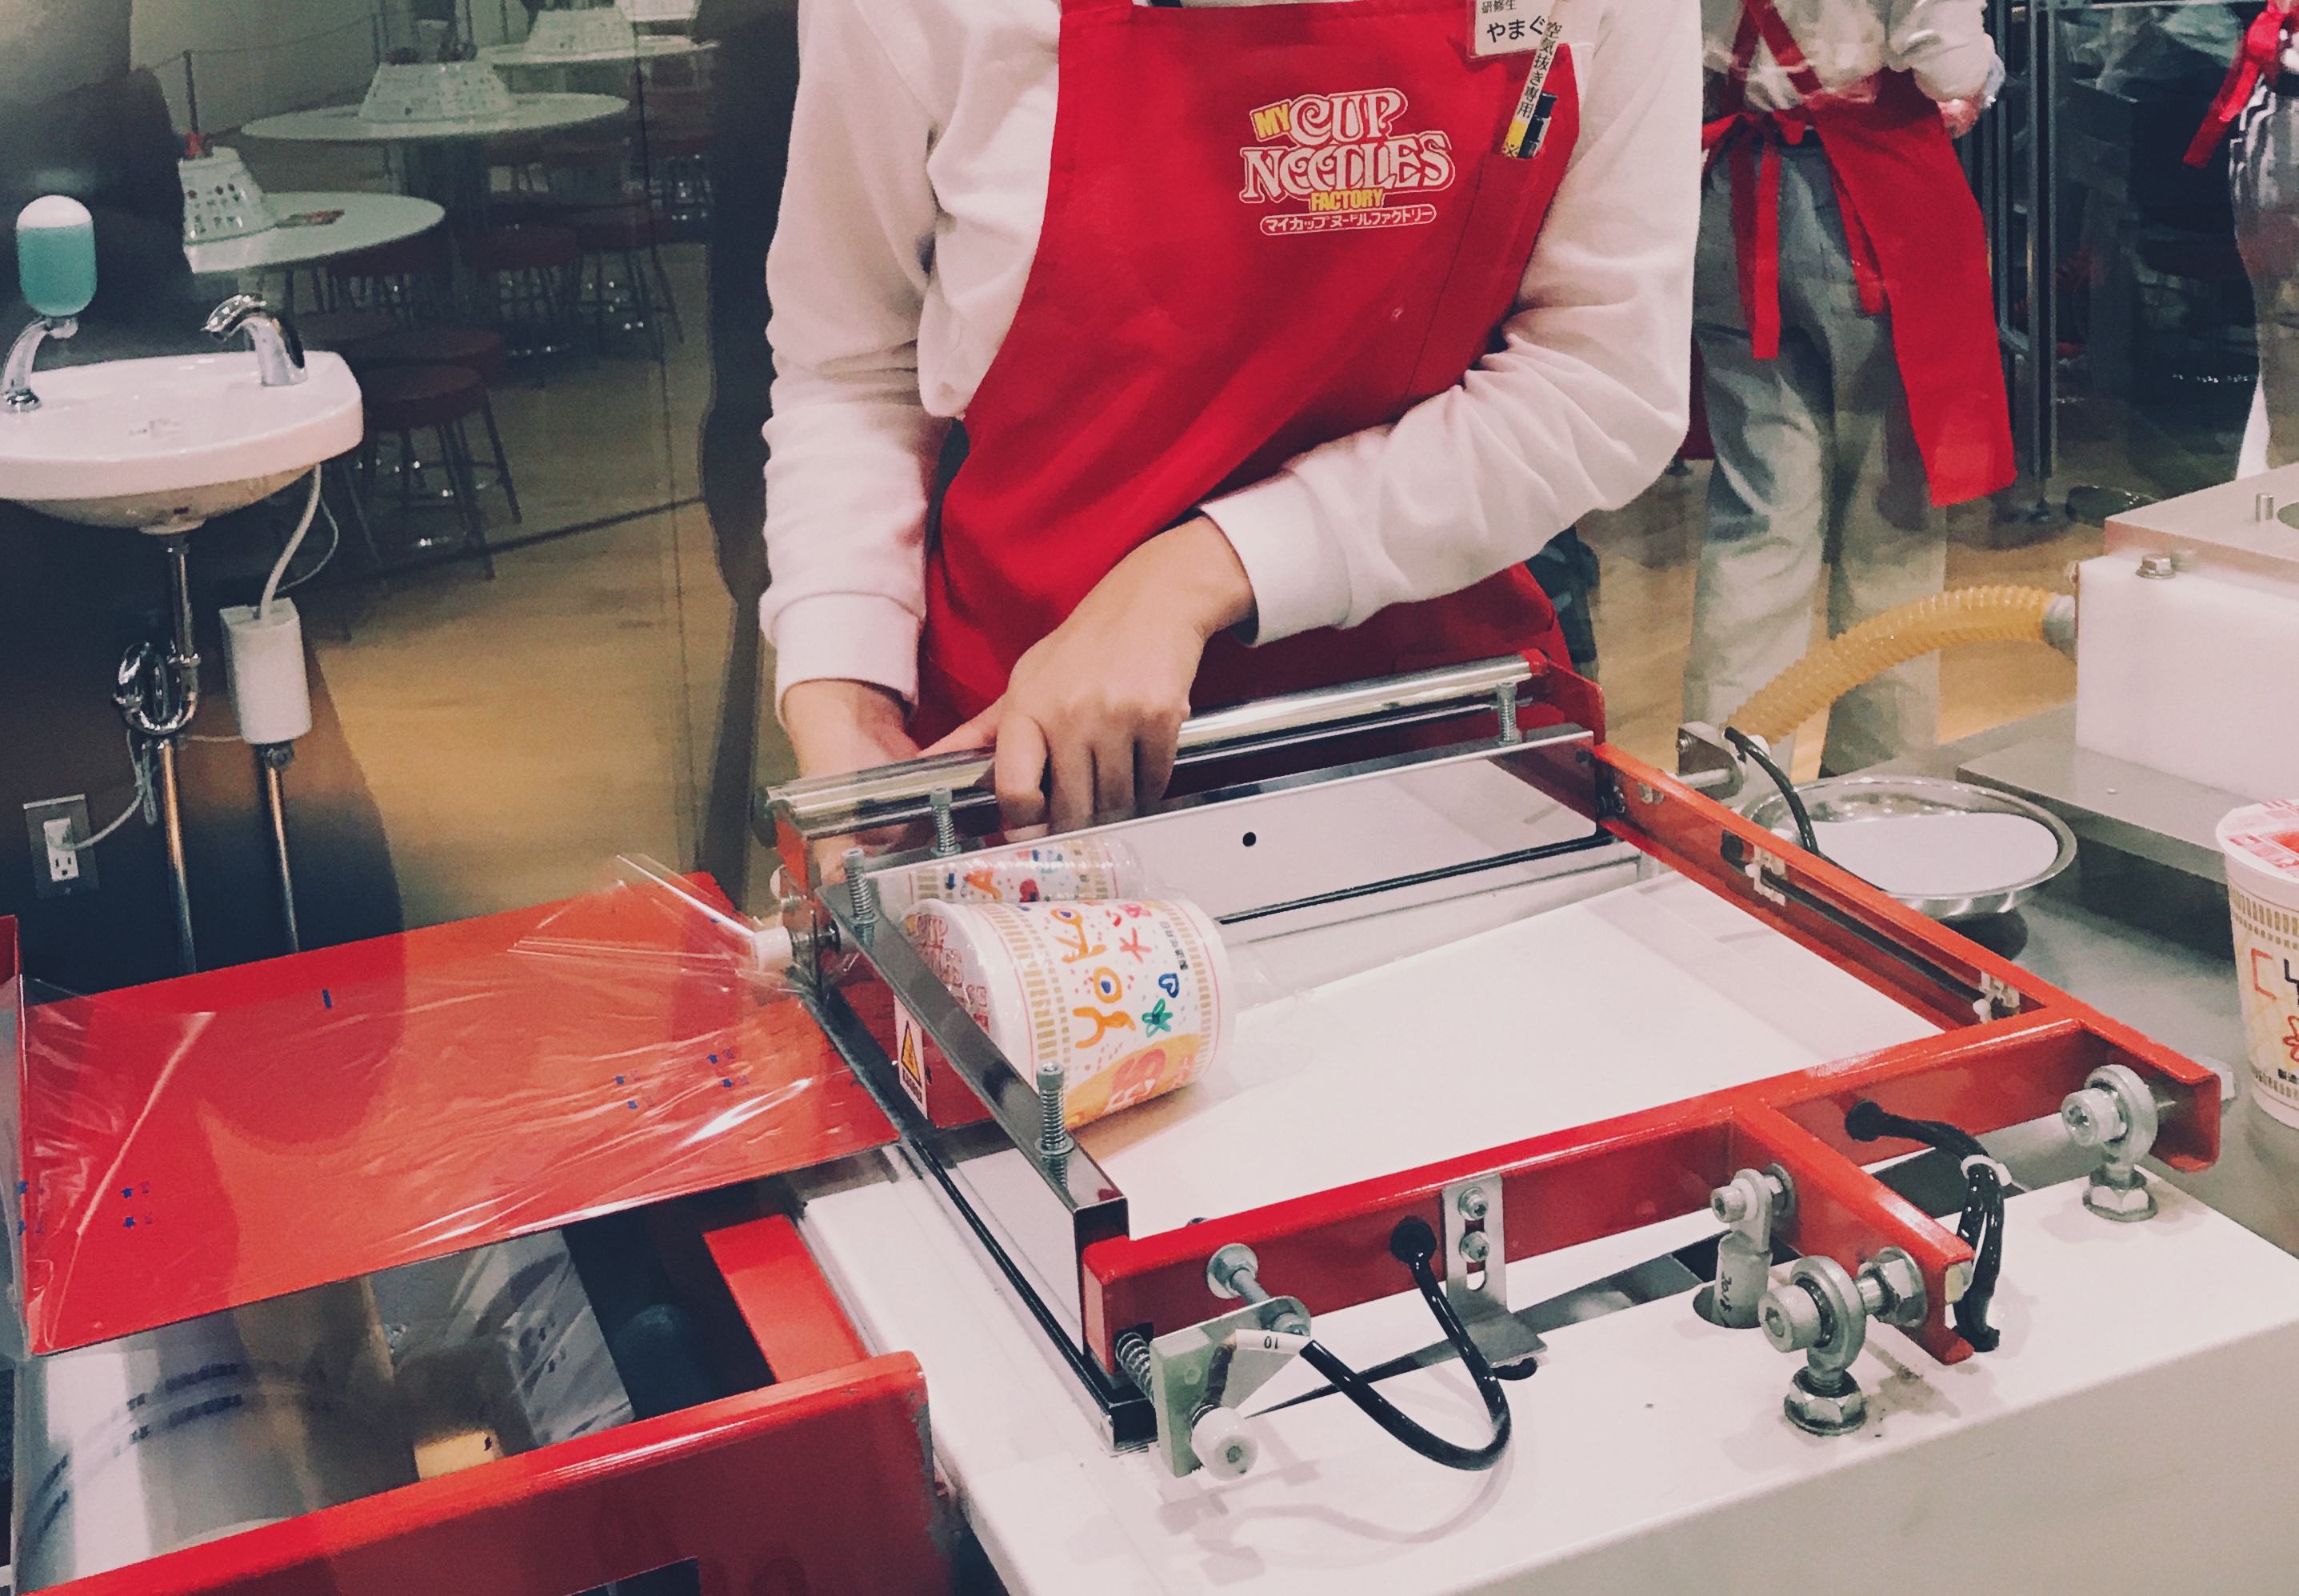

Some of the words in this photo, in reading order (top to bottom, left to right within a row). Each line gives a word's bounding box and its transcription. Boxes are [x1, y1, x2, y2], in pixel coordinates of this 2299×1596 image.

[1517, 21, 1564, 119] 空気抜き専用
[1252, 103, 1291, 140] MY
[1289, 89, 1405, 146] CUP
[1241, 134, 1453, 201] NOODLES
[1310, 188, 1385, 212] FACTORY
